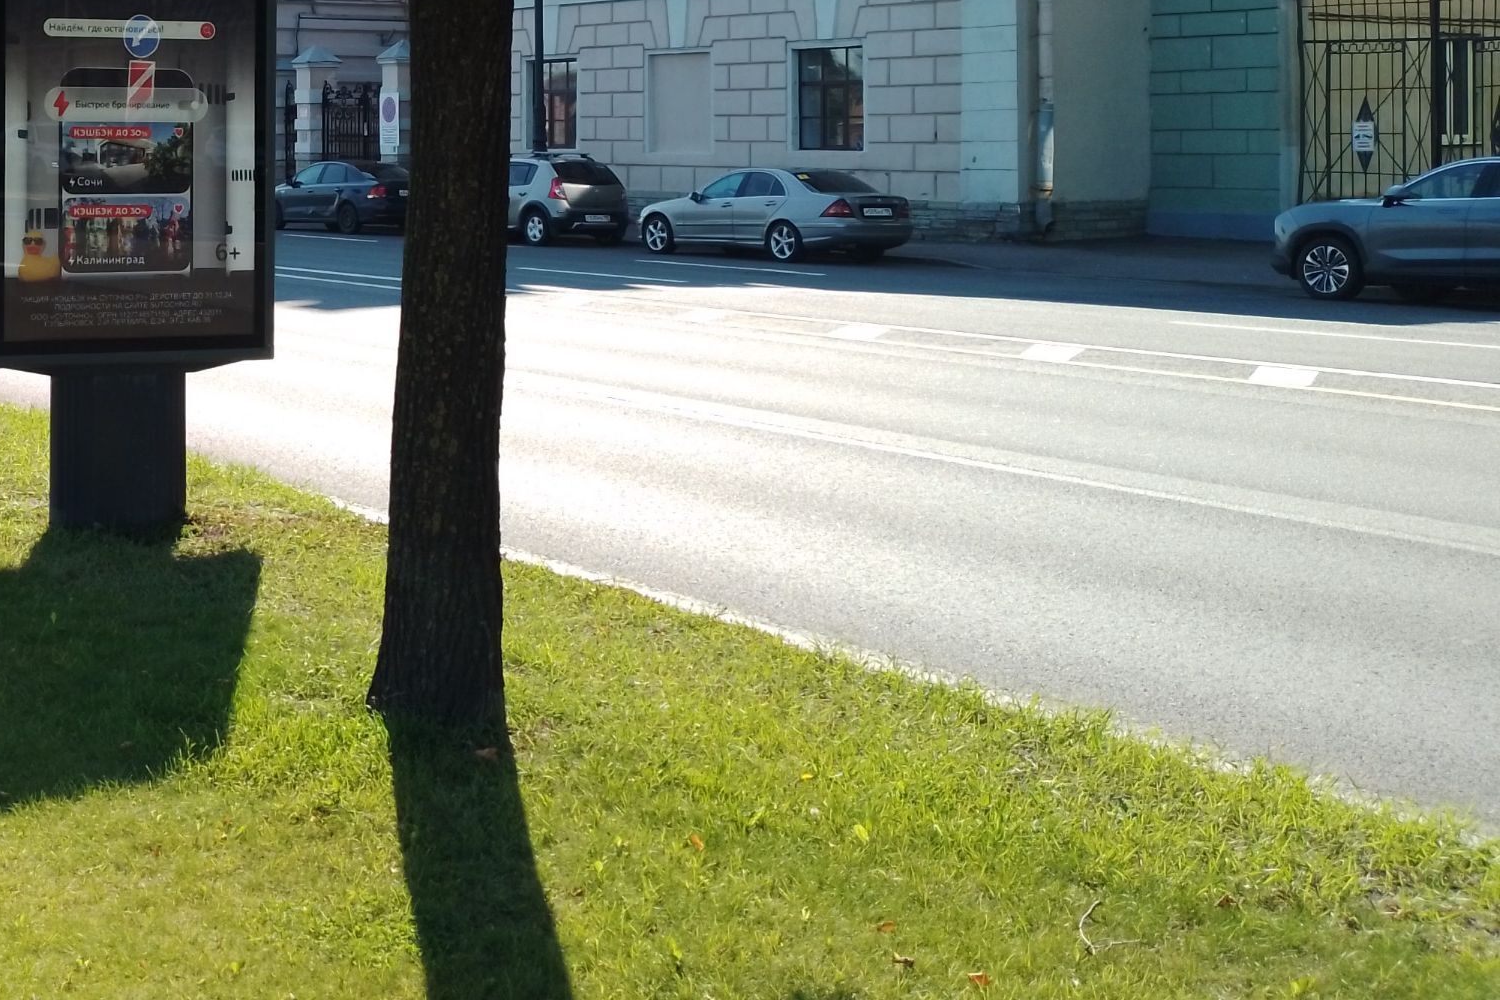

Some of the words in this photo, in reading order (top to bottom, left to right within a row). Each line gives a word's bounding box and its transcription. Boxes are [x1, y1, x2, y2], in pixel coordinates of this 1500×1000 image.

[49, 22, 85, 33] Найдём,
[87, 25, 102, 35] где
[75, 100, 111, 110] Быстрое
[73, 127, 113, 137] КЭШБЭК
[115, 128, 129, 137] ДО
[129, 128, 149, 137] 30%
[76, 176, 104, 187] Сочи
[73, 206, 113, 216] КЭШБЭК
[115, 206, 128, 216] ДО
[129, 206, 148, 215] 30%
[215, 242, 240, 262] 6+
[76, 255, 146, 266] Калининград
